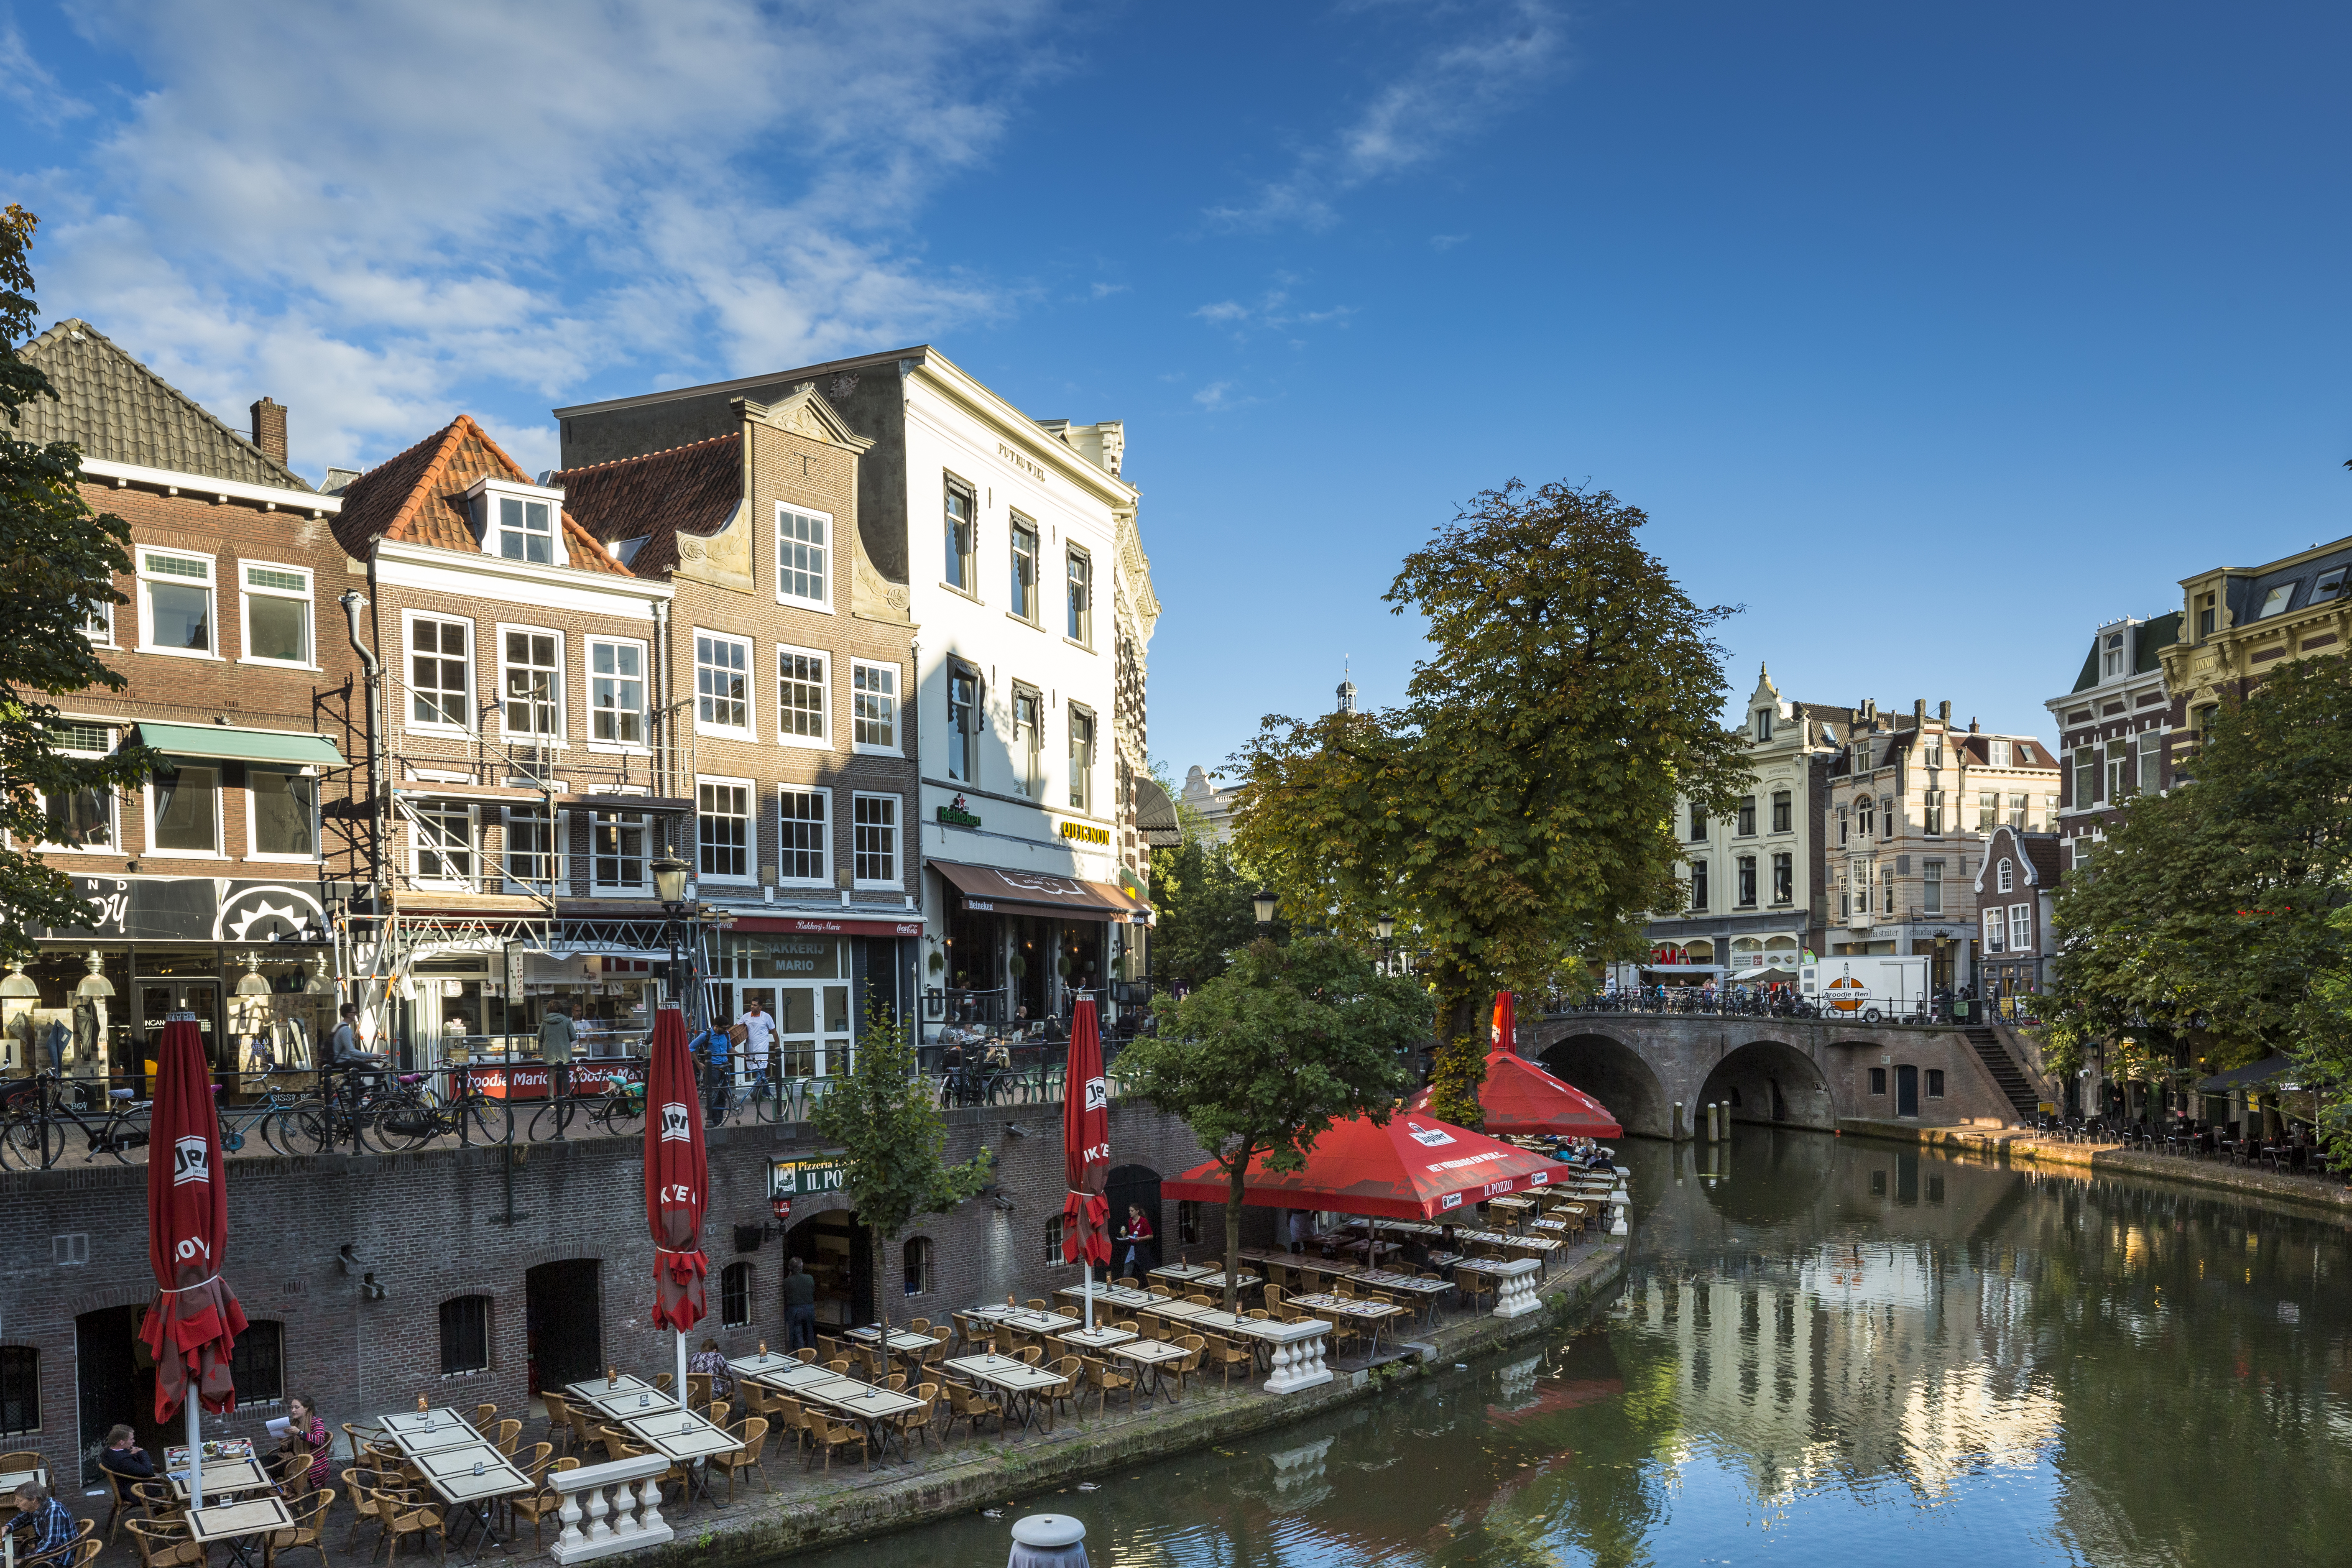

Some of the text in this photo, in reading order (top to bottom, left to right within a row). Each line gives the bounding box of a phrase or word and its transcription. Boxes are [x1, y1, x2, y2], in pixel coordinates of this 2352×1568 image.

[2195, 657, 2214, 672] ANNO
[941, 806, 981, 827] Heineken
[1063, 821, 1110, 845] QUIGNON
[969, 900, 993, 911] Heineken
[1127, 915, 1145, 924] Heineken
[796, 920, 841, 932] Bakkerij Mario
[1909, 927, 1932, 937] claudia
[1858, 929, 1899, 939] claudia sträter
[1643, 949, 1691, 965] EMA
[776, 960, 814, 970] MARIO
[617, 1068, 644, 1080] Mari
[457, 1073, 507, 1088] roodje
[272, 1093, 315, 1103] SISSY-BO
[1415, 1132, 1447, 1144] Jupiler
[798, 1161, 833, 1171] Pizzeria
[1425, 1163, 1444, 1172] HET
[1438, 1157, 1476, 1169] VREEBURG
[1470, 1155, 1485, 1164] EN
[1479, 1152, 1499, 1161] WIJK
[806, 1172, 821, 1191] IL
[1484, 1179, 1513, 1197] IL POZZO
[1448, 1195, 1461, 1205] Jupiler
